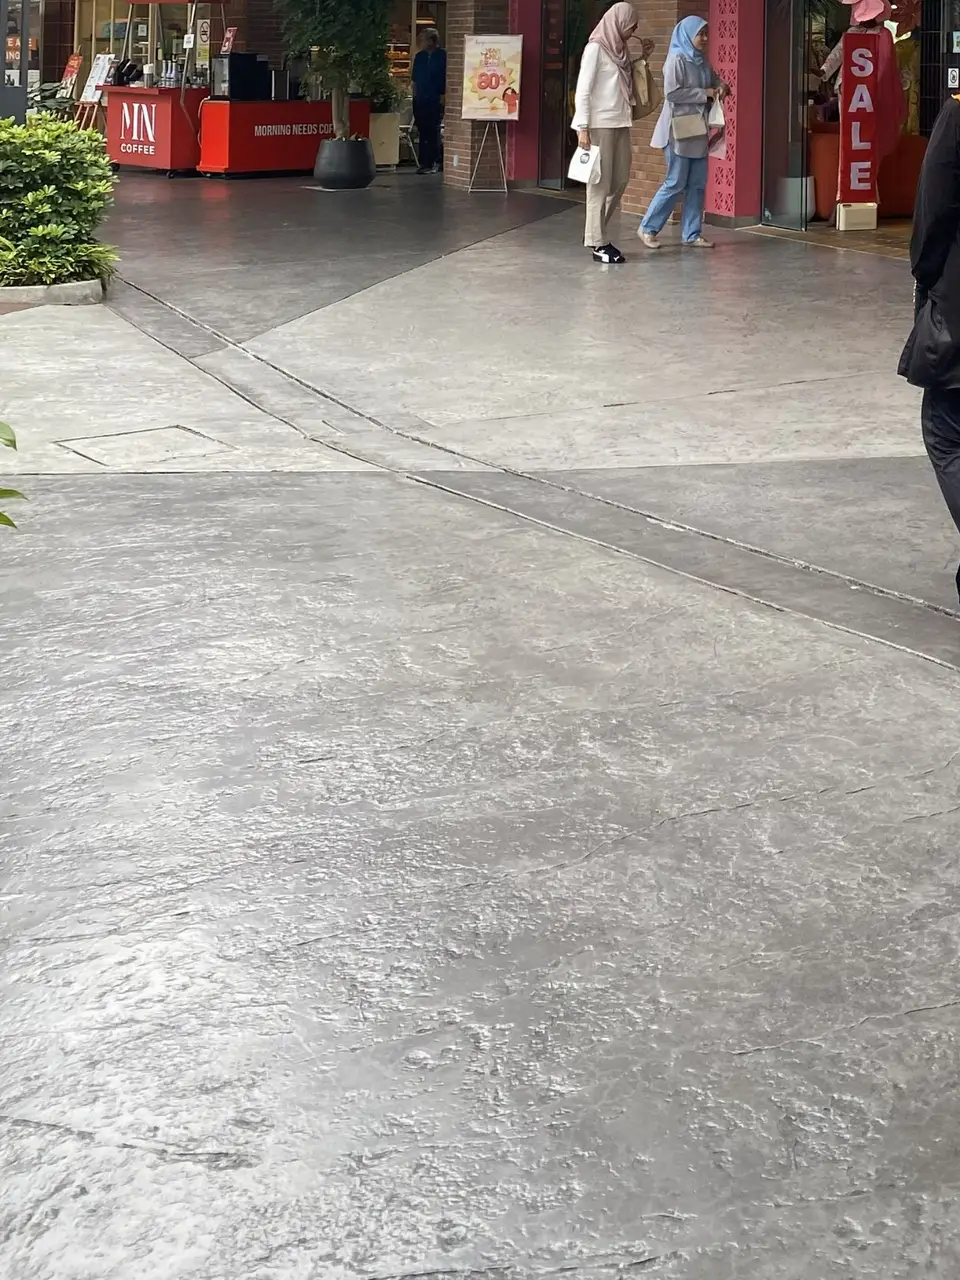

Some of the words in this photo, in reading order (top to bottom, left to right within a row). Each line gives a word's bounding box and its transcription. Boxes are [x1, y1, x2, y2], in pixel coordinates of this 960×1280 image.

[120, 102, 157, 143] MN
[254, 124, 291, 137] MORNING
[292, 123, 318, 135] NEEDS
[319, 123, 335, 135] COF
[847, 47, 875, 191] SALE
[120, 143, 155, 155] COFFEE
